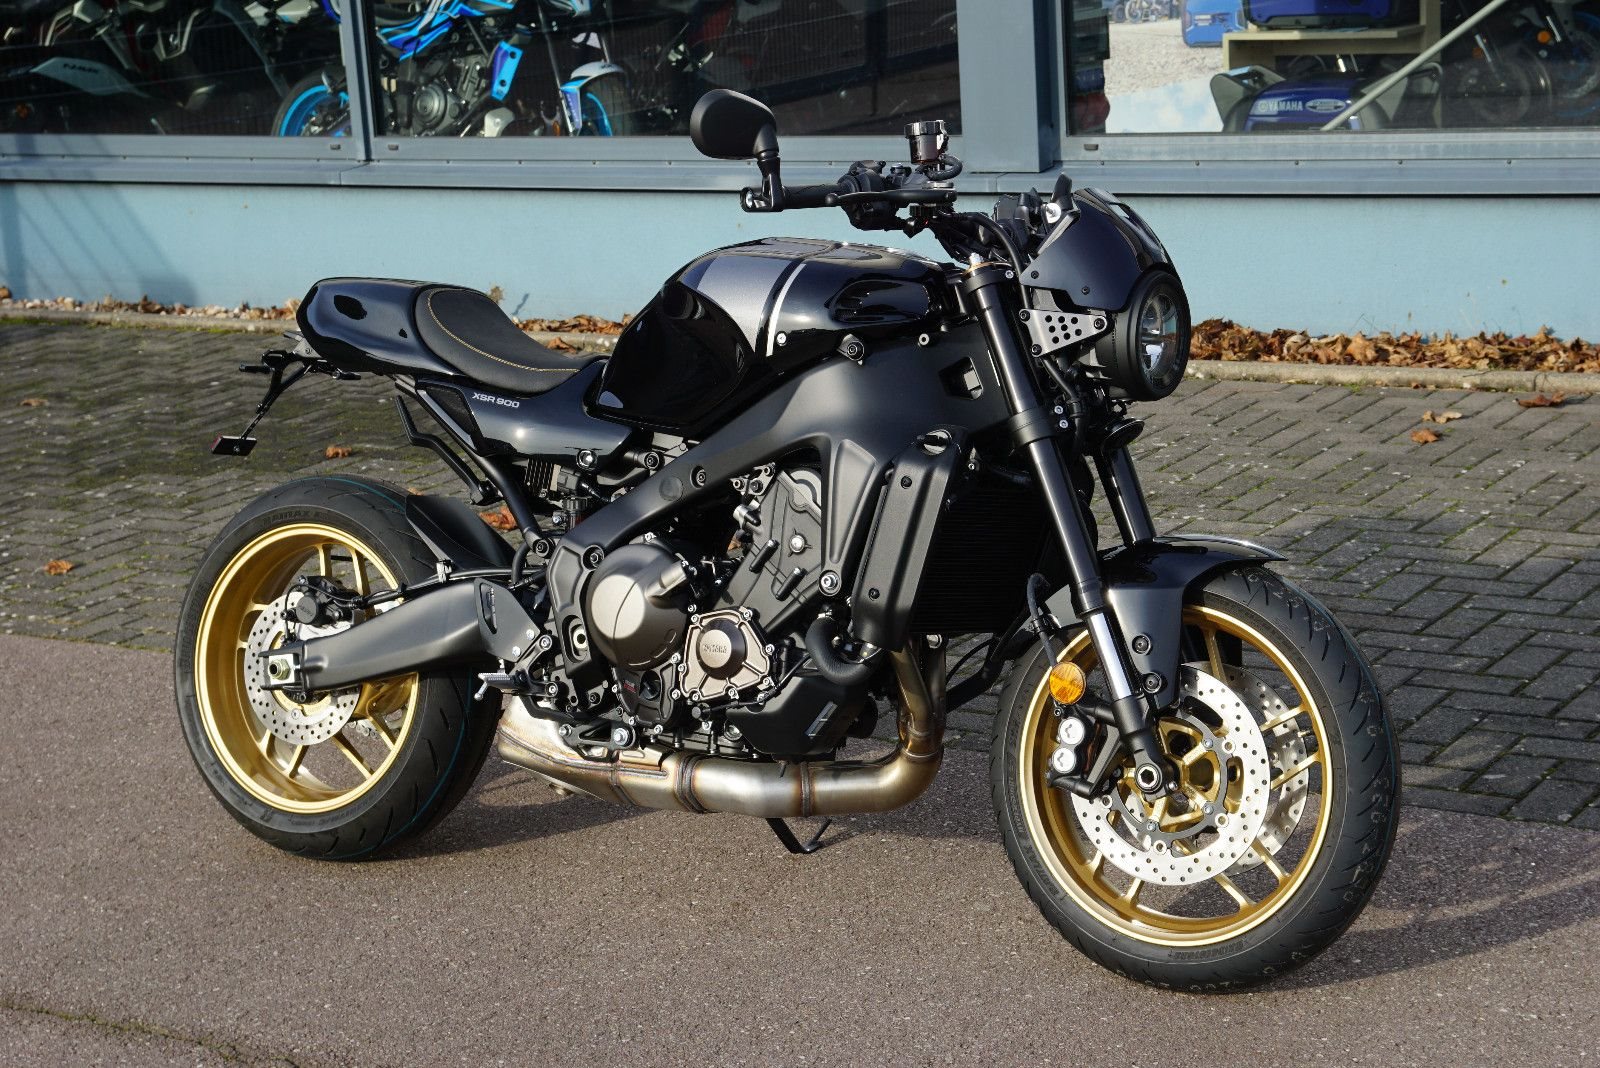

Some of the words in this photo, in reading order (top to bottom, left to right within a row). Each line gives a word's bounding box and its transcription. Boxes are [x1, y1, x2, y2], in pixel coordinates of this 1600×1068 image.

[1268, 100, 1303, 112] YAMAHA
[472, 392, 495, 403] XSR
[496, 397, 520, 408] 900
